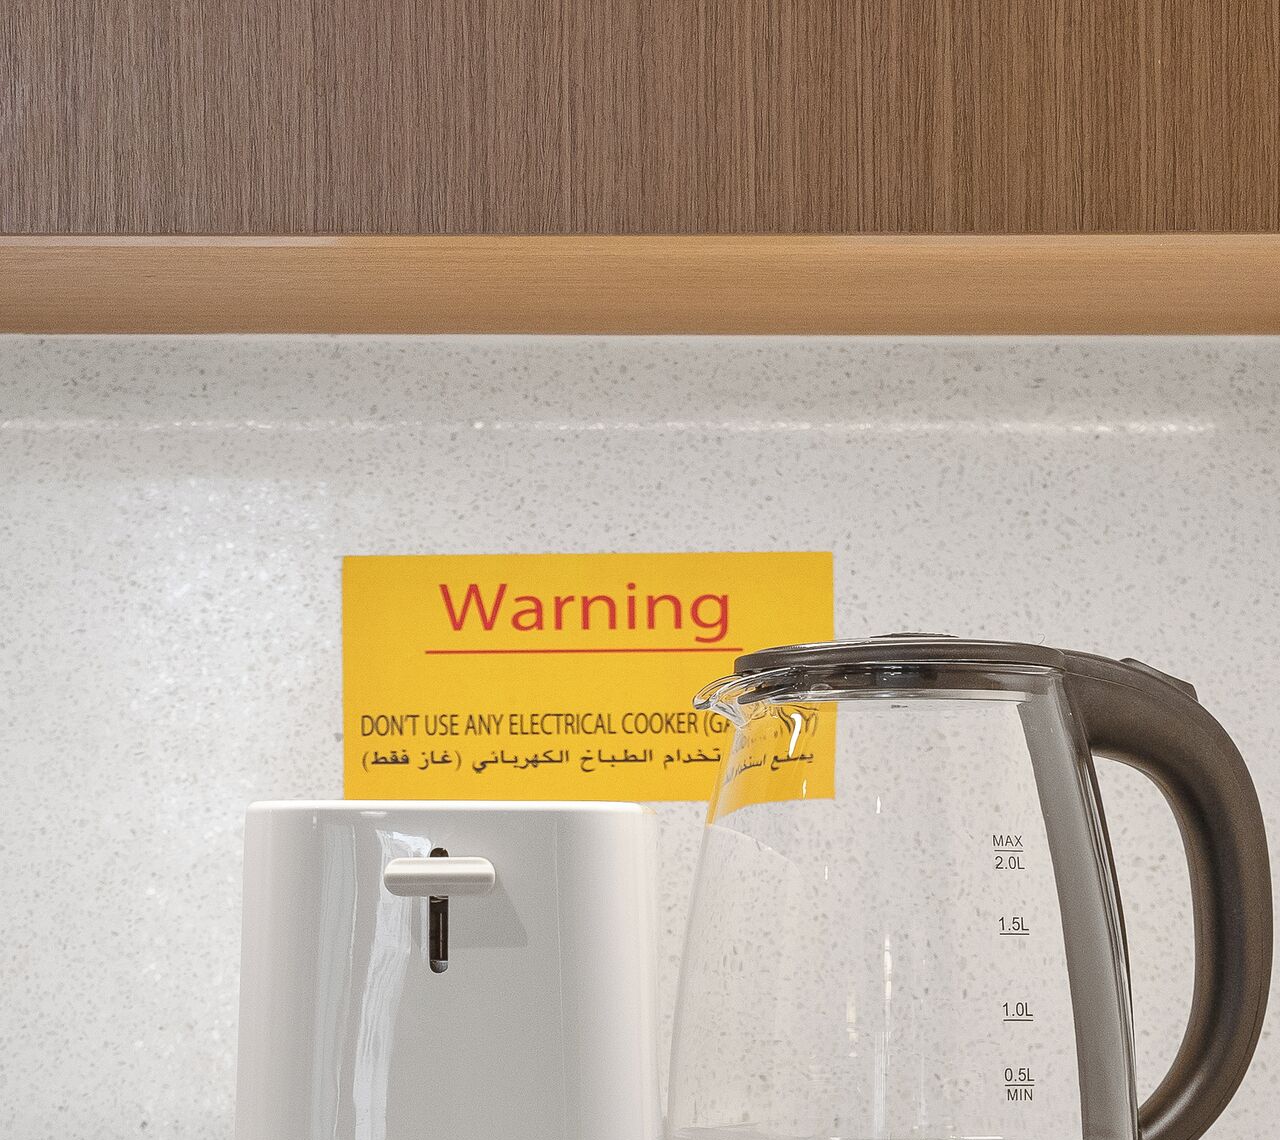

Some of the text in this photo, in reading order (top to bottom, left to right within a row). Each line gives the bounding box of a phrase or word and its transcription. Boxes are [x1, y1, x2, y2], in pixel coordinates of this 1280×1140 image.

[439, 582, 729, 643] Warning
[361, 714, 420, 737] DON'T
[424, 714, 459, 736] USE
[464, 714, 504, 736] ANY
[509, 713, 616, 736] ELECTRICAL
[621, 712, 698, 735] COOKER
[580, 749, 653, 772] الطباخ
[992, 834, 1023, 847] MAX
[994, 855, 1025, 870] 2.0L
[998, 916, 1029, 931] 1.5L
[1002, 1002, 1033, 1017] 1.0L
[1004, 1067, 1035, 1082] 0.5L
[1007, 1088, 1033, 1101] MIN
